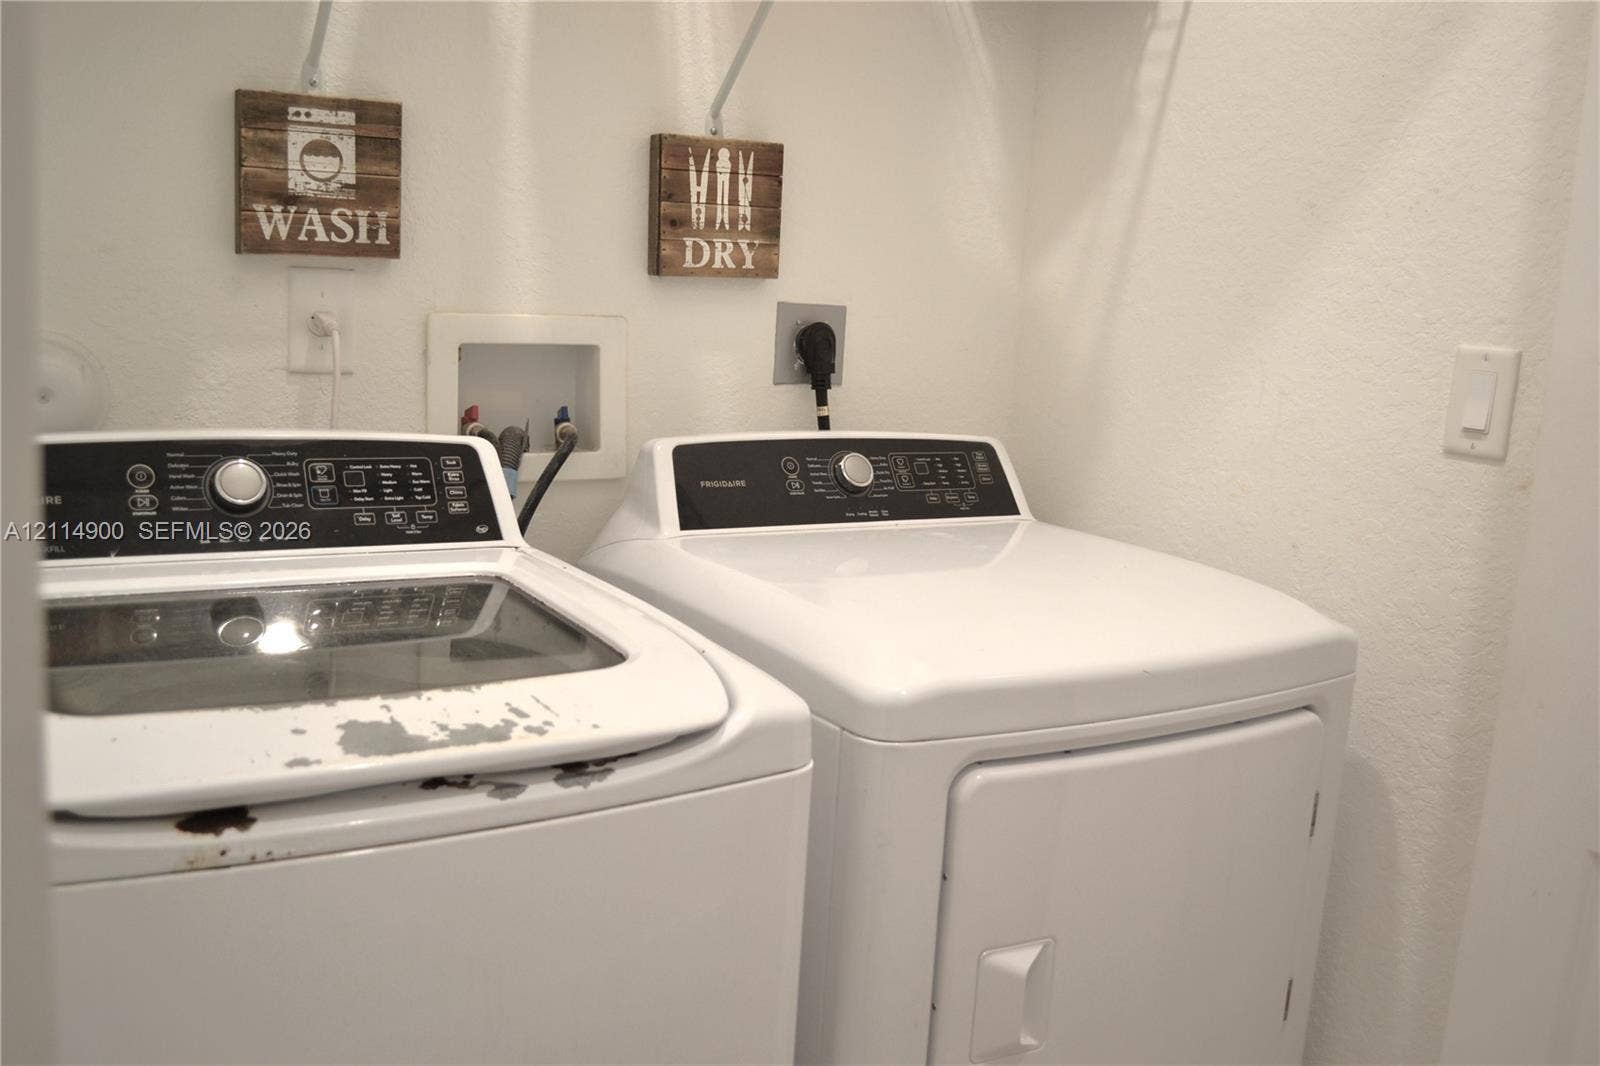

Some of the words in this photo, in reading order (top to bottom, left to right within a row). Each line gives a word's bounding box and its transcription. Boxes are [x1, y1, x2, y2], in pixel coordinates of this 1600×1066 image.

[253, 203, 390, 245] WASH
[682, 237, 759, 269] DRY
[700, 480, 747, 488] FRIGIDAIRE
